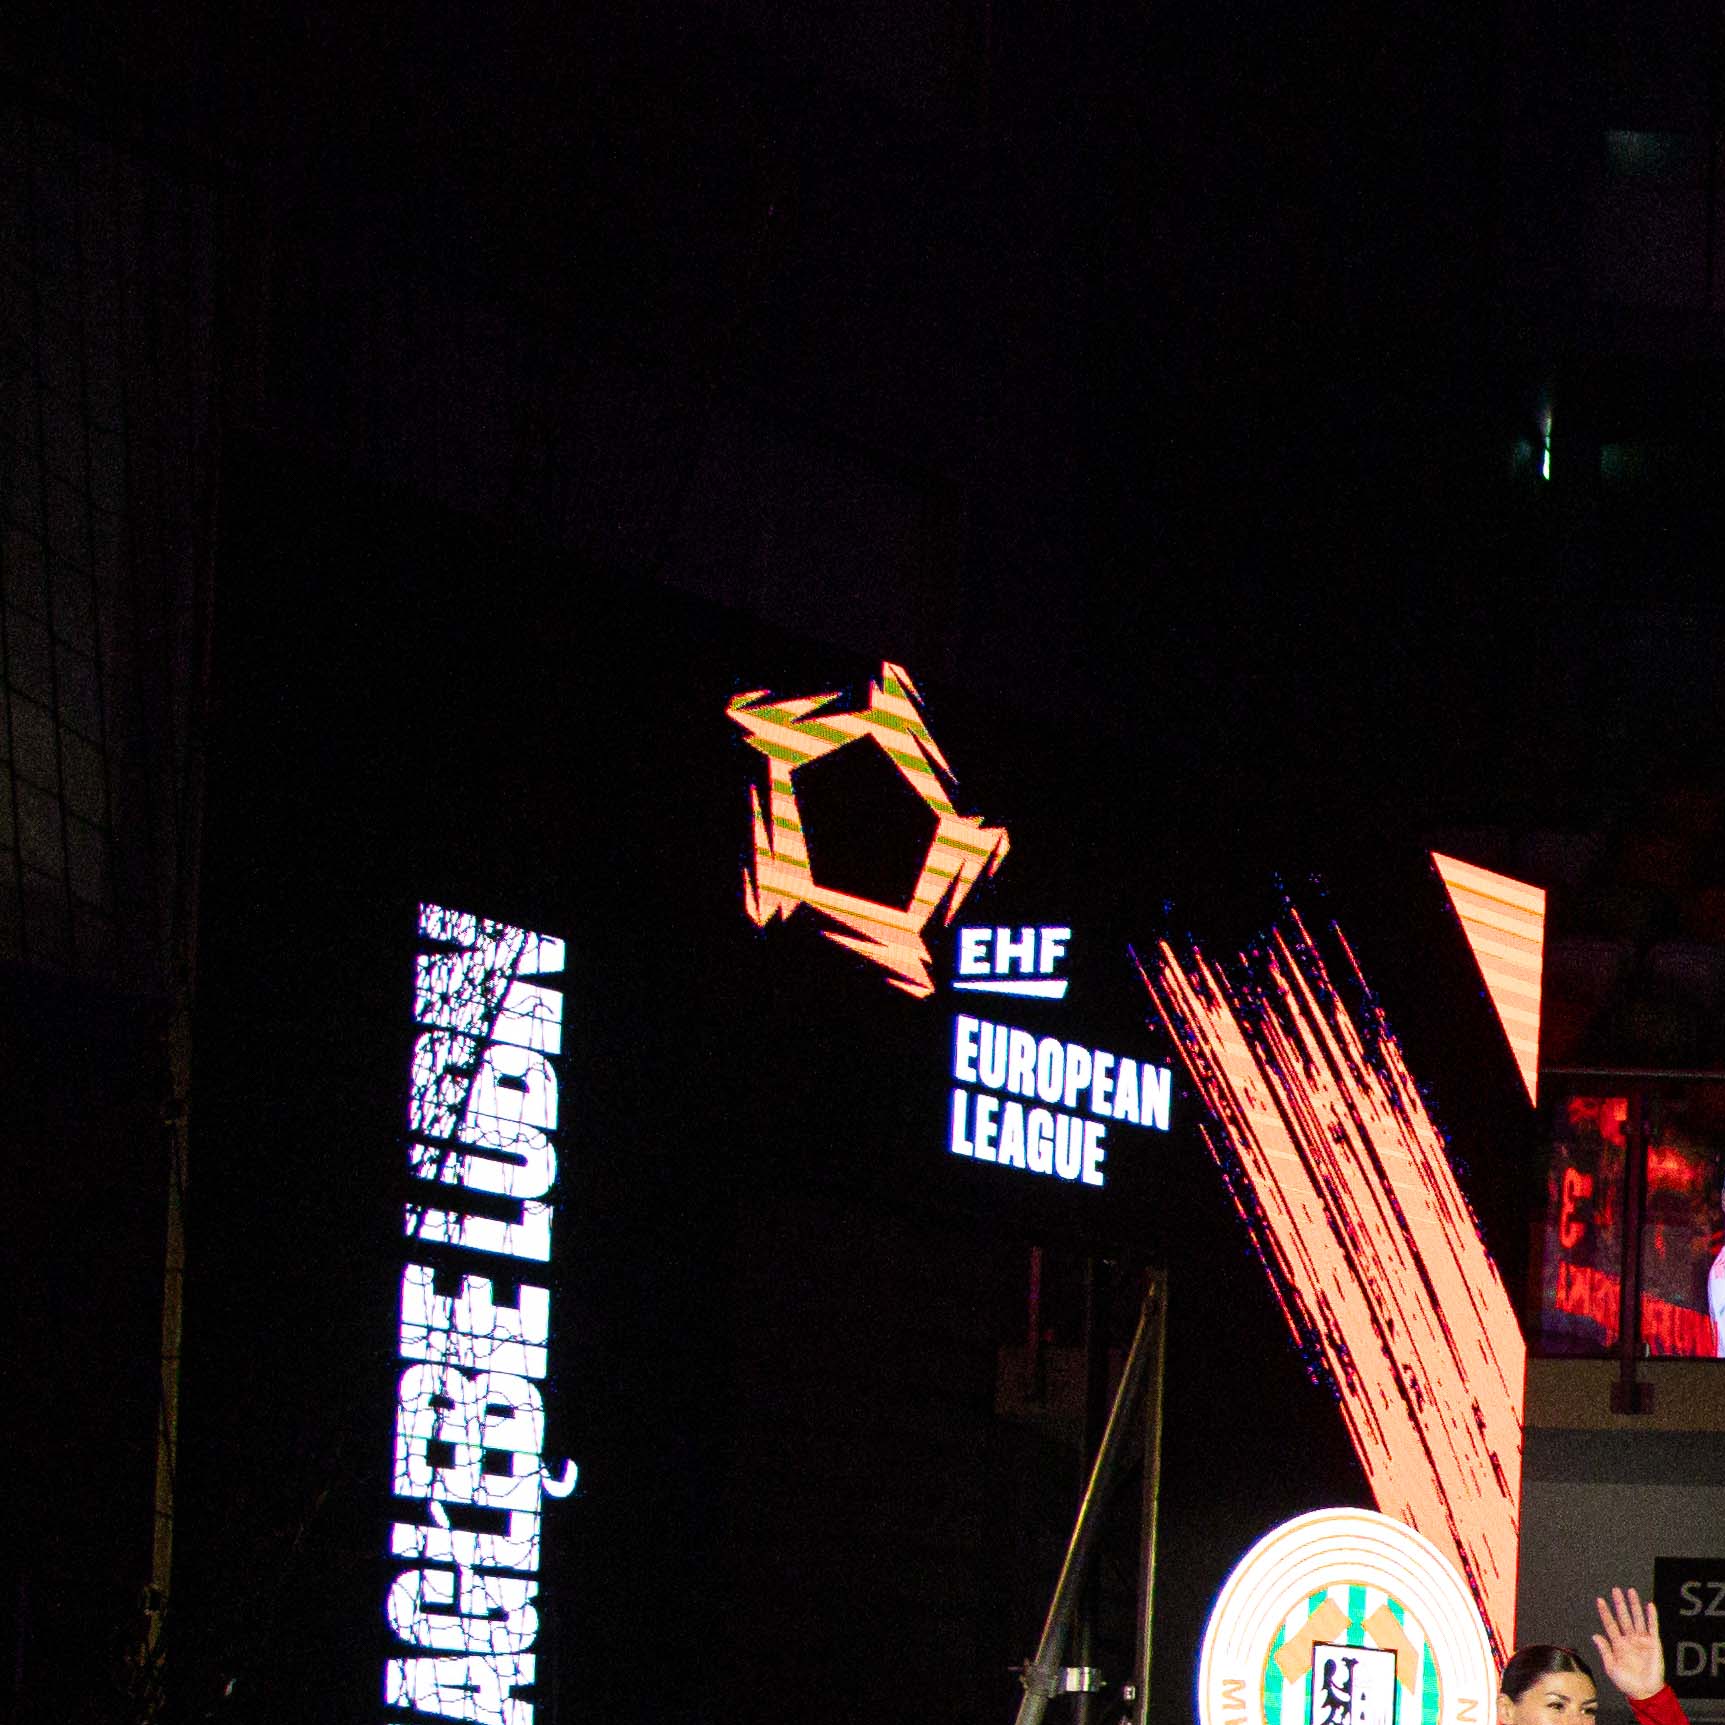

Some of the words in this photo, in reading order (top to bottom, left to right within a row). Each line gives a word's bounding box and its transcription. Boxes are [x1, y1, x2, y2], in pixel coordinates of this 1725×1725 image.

[957, 926, 1071, 975] EHF
[404, 902, 566, 1262] LUBIN
[954, 1013, 1172, 1131] EUROPEAN
[951, 1087, 1106, 1187] LEAGUE
